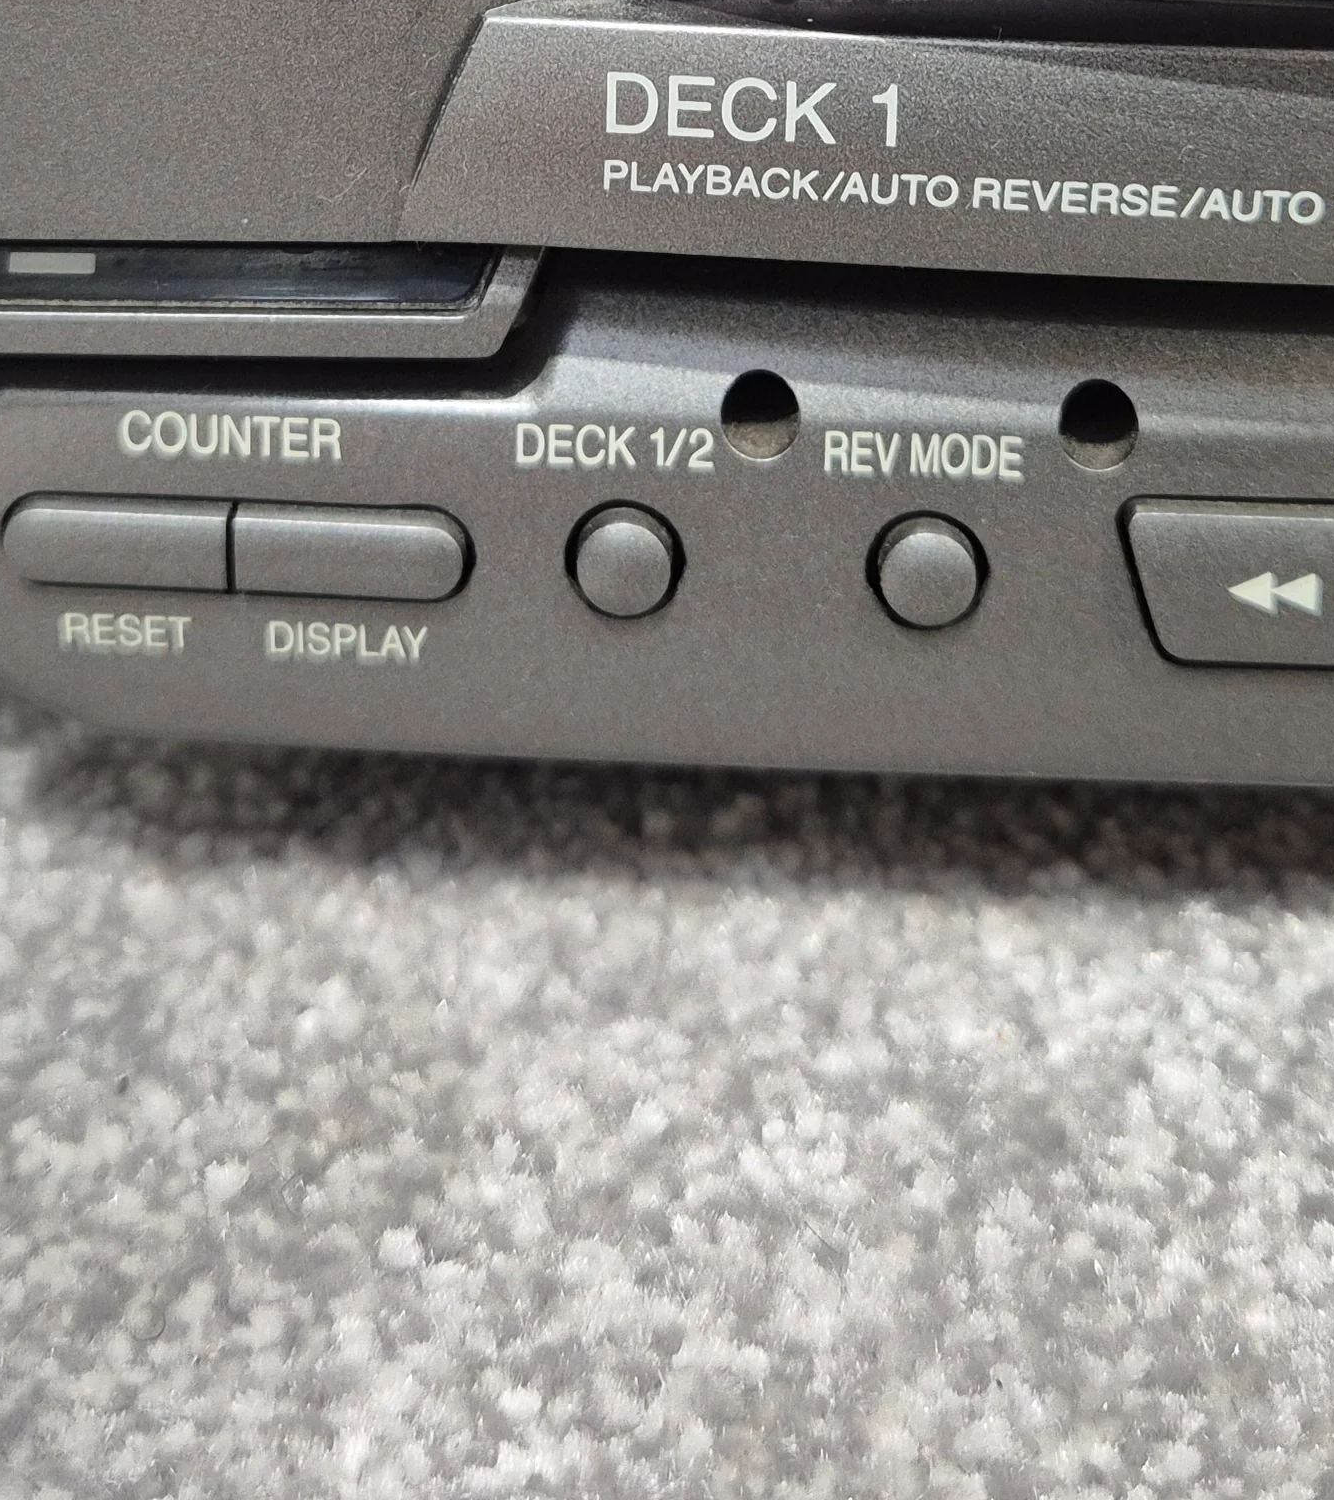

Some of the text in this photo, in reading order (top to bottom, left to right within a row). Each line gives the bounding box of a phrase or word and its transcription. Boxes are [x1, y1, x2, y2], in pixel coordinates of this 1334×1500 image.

[603, 70, 903, 149] DECK 1
[602, 159, 960, 209] PLAYBACK/AUTO
[972, 176, 1323, 225] REVERSE/AUTO
[118, 409, 343, 461] COUNTER
[514, 423, 715, 474] DECK 1/2
[822, 430, 1024, 480] REV MODE
[64, 613, 192, 653] RESET
[267, 620, 428, 662] DISPLAY
